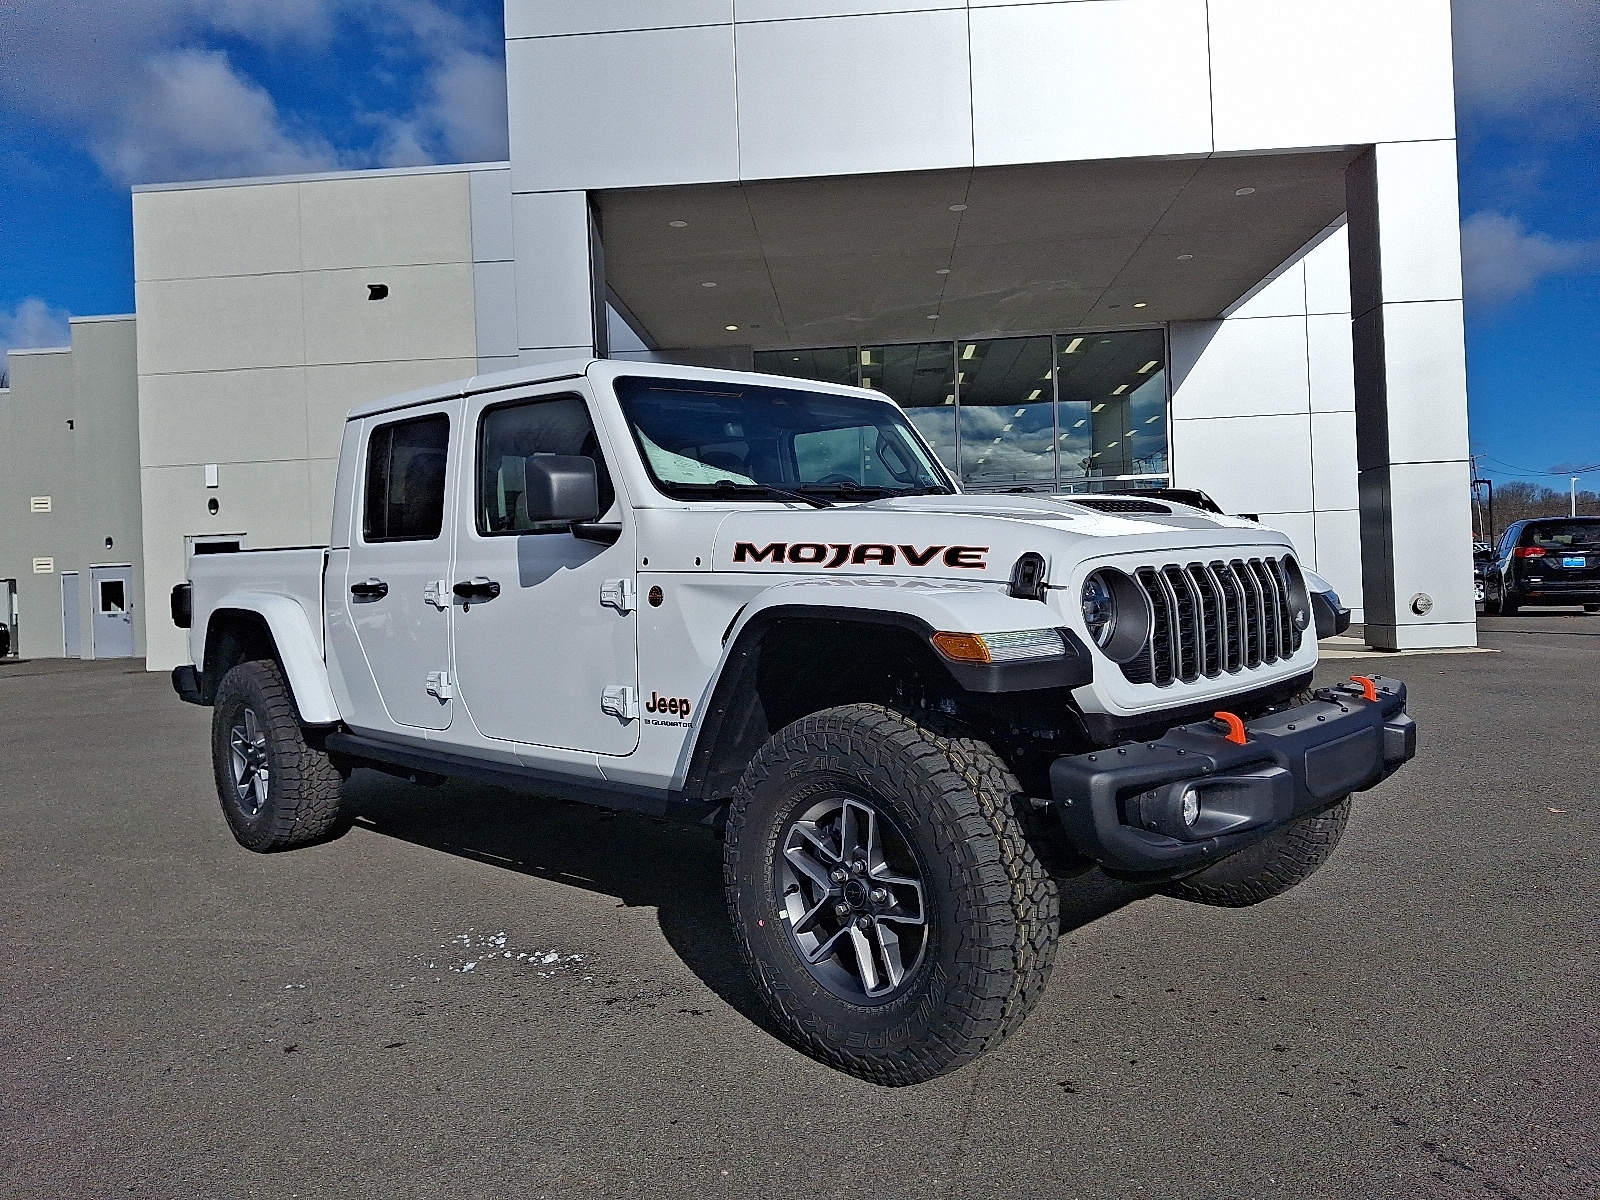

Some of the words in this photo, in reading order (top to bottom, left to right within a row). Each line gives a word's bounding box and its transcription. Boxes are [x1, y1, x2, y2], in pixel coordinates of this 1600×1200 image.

[733, 541, 990, 569] MOJAVE
[646, 691, 691, 719] Jeep
[651, 719, 694, 728] GLADIATOR
